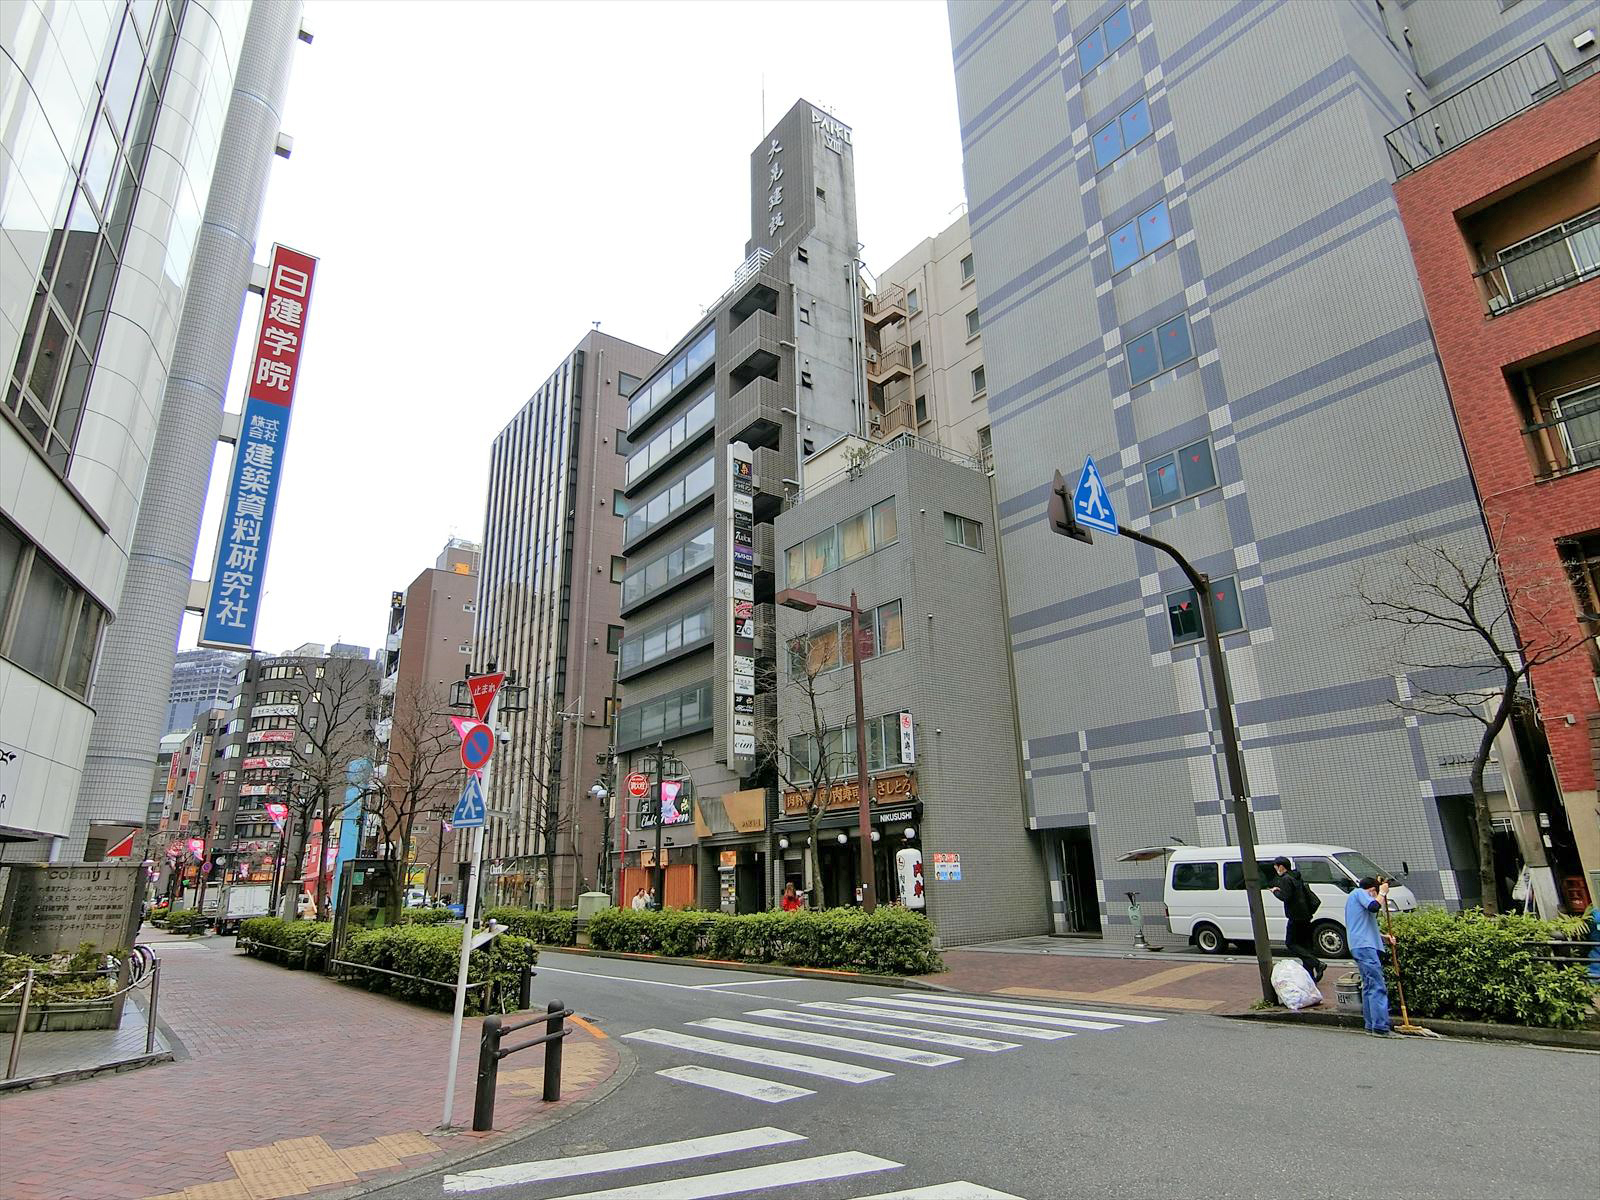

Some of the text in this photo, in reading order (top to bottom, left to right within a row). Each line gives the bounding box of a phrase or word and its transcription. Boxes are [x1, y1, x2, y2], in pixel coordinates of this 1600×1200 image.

[255, 264, 309, 392] 日建学院
[215, 441, 275, 628] 建築資料研究社
[473, 683, 496, 696] 止まれ
[877, 779, 911, 796] さしとろ
[880, 811, 912, 822] NIKUSUSHI
